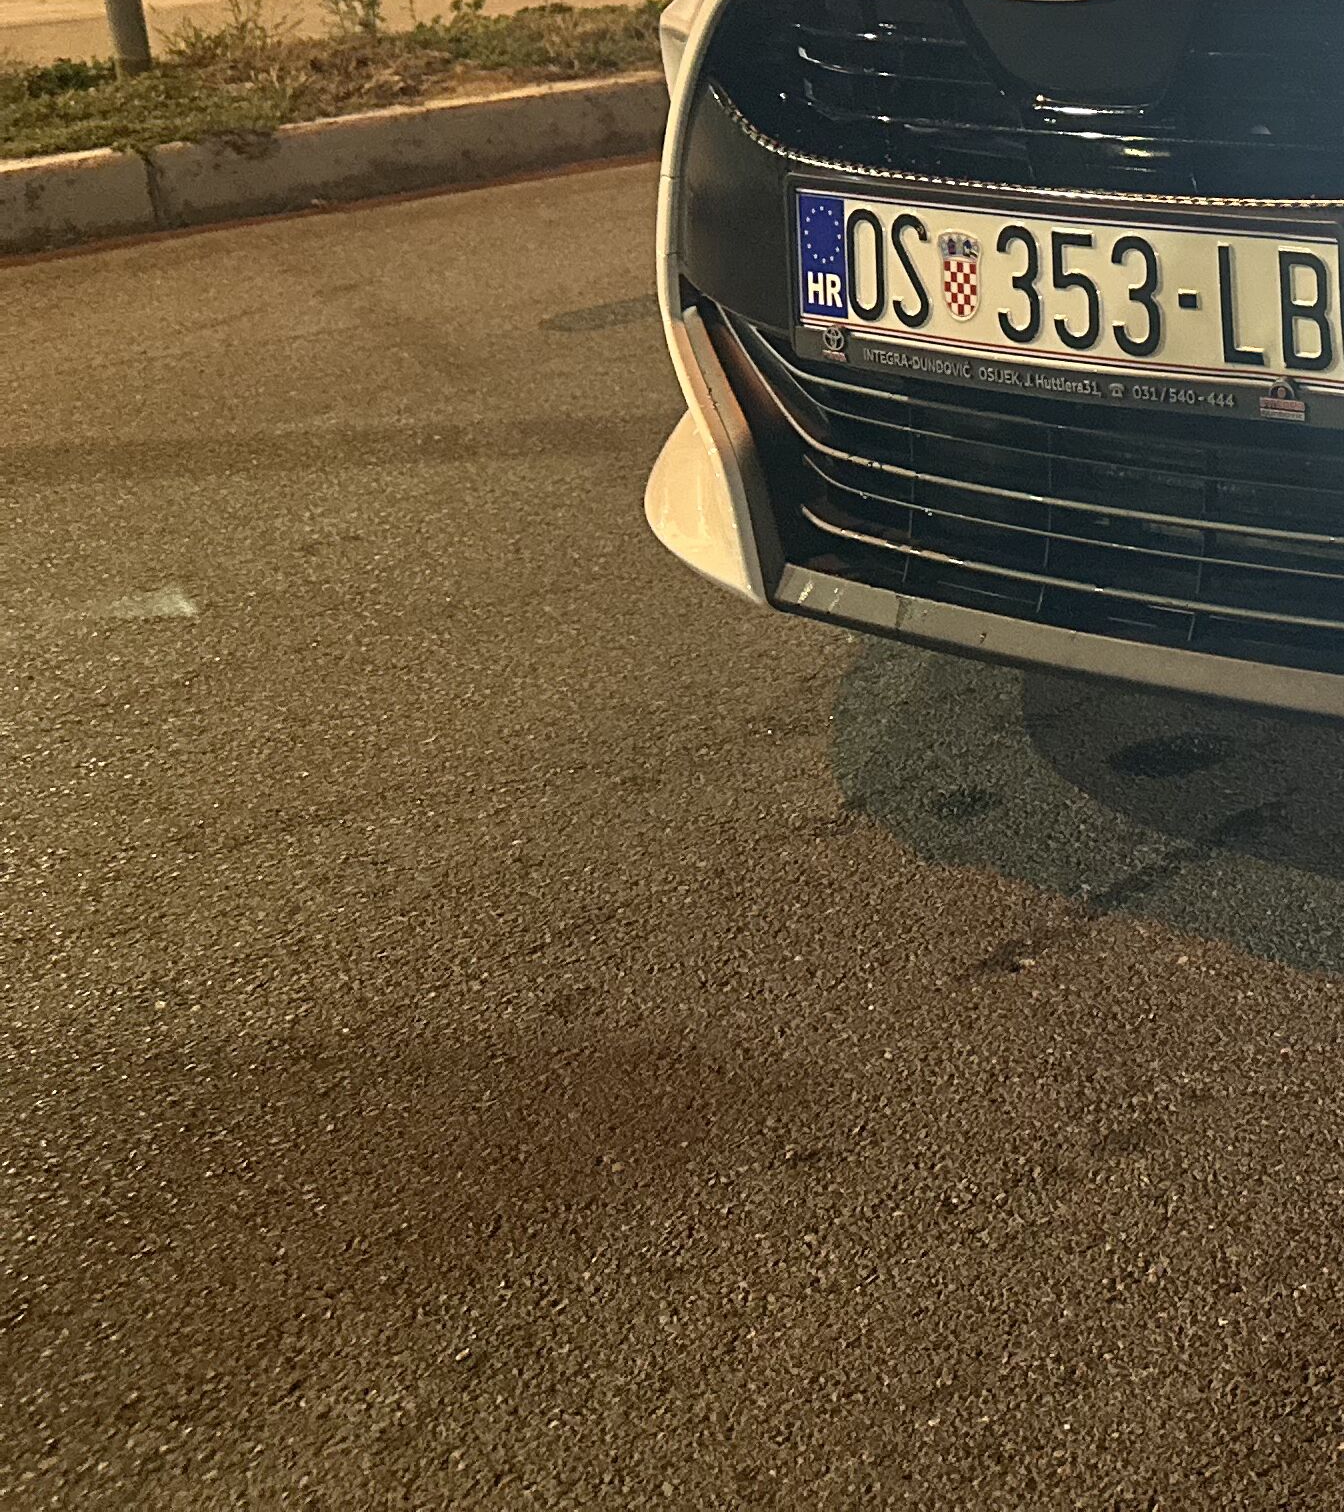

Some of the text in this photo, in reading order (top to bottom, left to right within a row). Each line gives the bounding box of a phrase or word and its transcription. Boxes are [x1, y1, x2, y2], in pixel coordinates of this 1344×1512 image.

[807, 271, 843, 309] HR
[846, 208, 1334, 372] OS 353-LB
